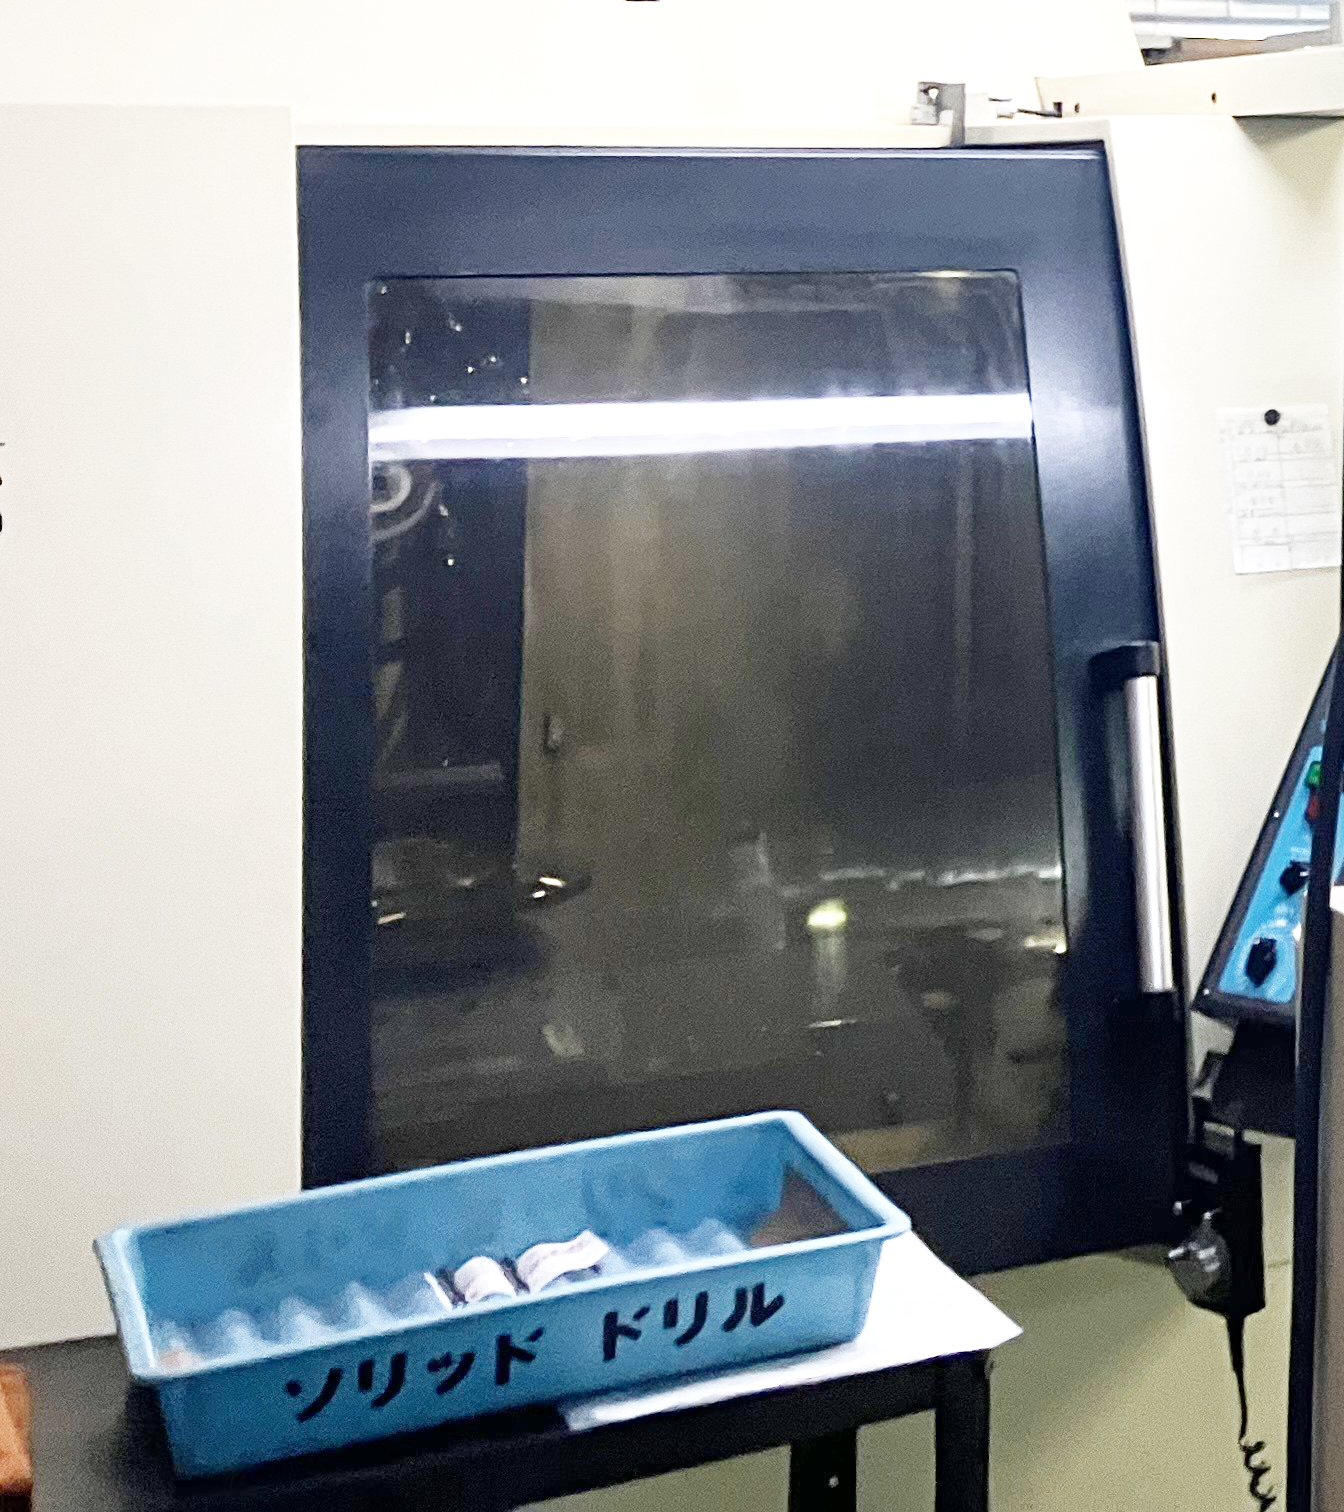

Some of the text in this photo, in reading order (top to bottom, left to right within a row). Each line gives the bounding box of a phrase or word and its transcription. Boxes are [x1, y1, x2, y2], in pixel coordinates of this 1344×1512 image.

[285, 1281, 787, 1422] ソリッド ドリル
